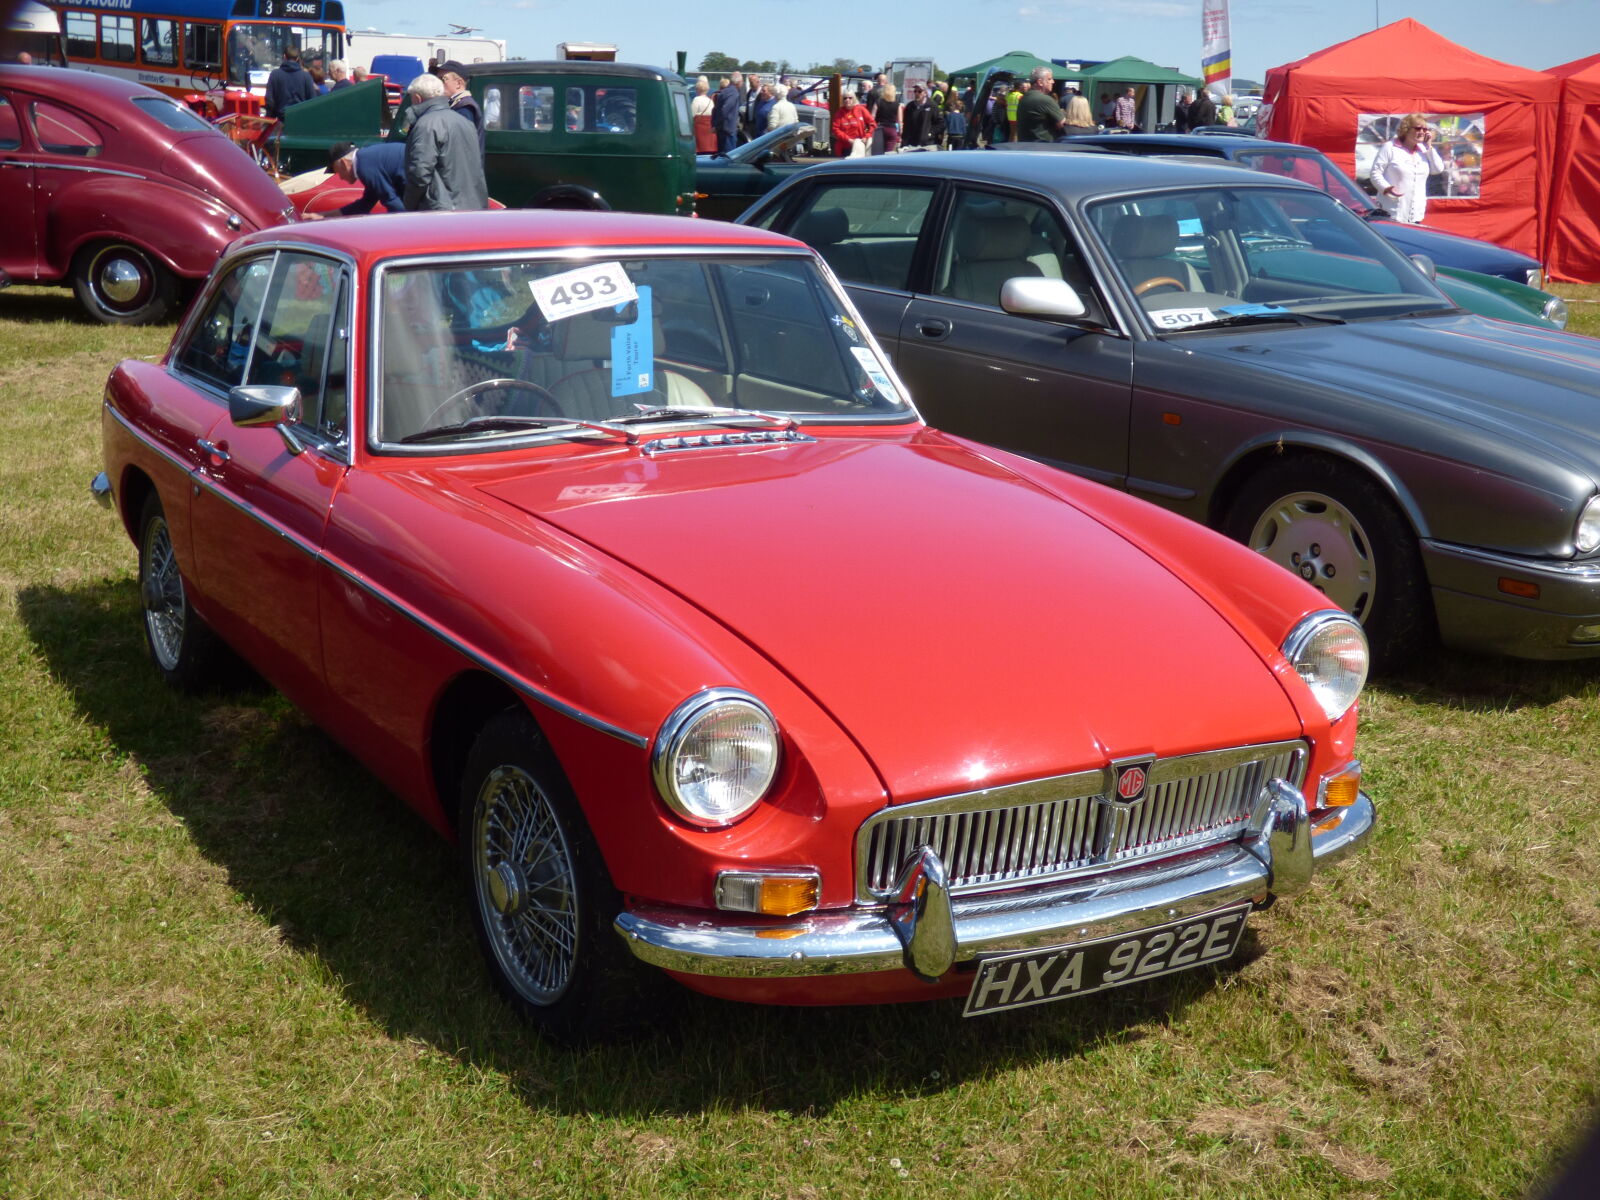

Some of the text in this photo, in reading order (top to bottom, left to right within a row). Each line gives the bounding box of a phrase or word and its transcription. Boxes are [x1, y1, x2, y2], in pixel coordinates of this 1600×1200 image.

[265, 0, 316, 15] 3 SCONE
[550, 275, 617, 306] 493
[1161, 312, 1204, 325] 507
[1120, 770, 1143, 796] MG
[974, 913, 1242, 1009] HXA 922E
